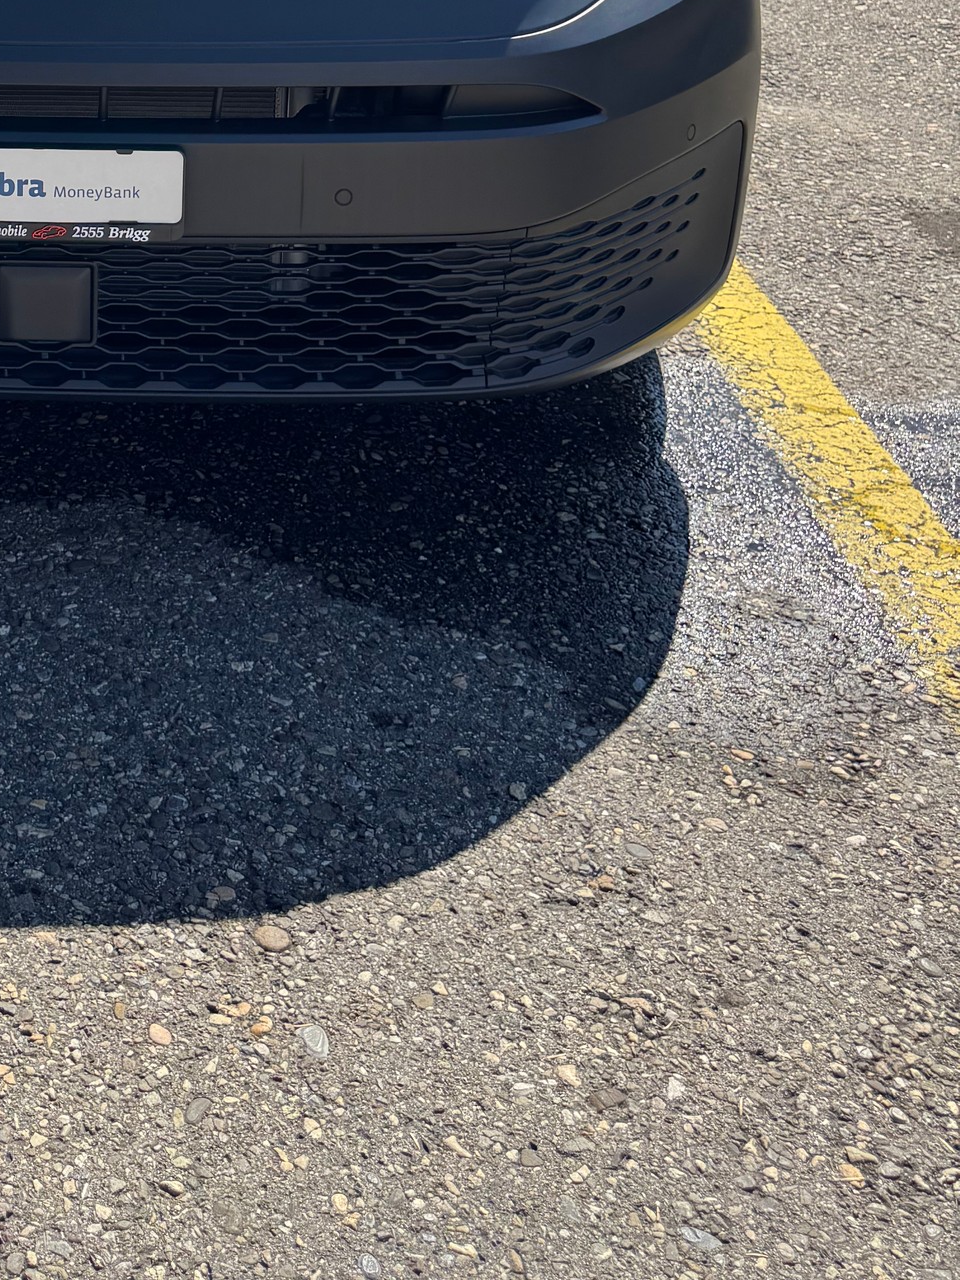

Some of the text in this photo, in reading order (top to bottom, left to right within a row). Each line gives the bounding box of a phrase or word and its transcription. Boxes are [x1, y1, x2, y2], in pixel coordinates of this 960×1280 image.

[53, 185, 141, 201] MoneyBank
[72, 226, 105, 238] 2555
[108, 226, 151, 242] Brügg
